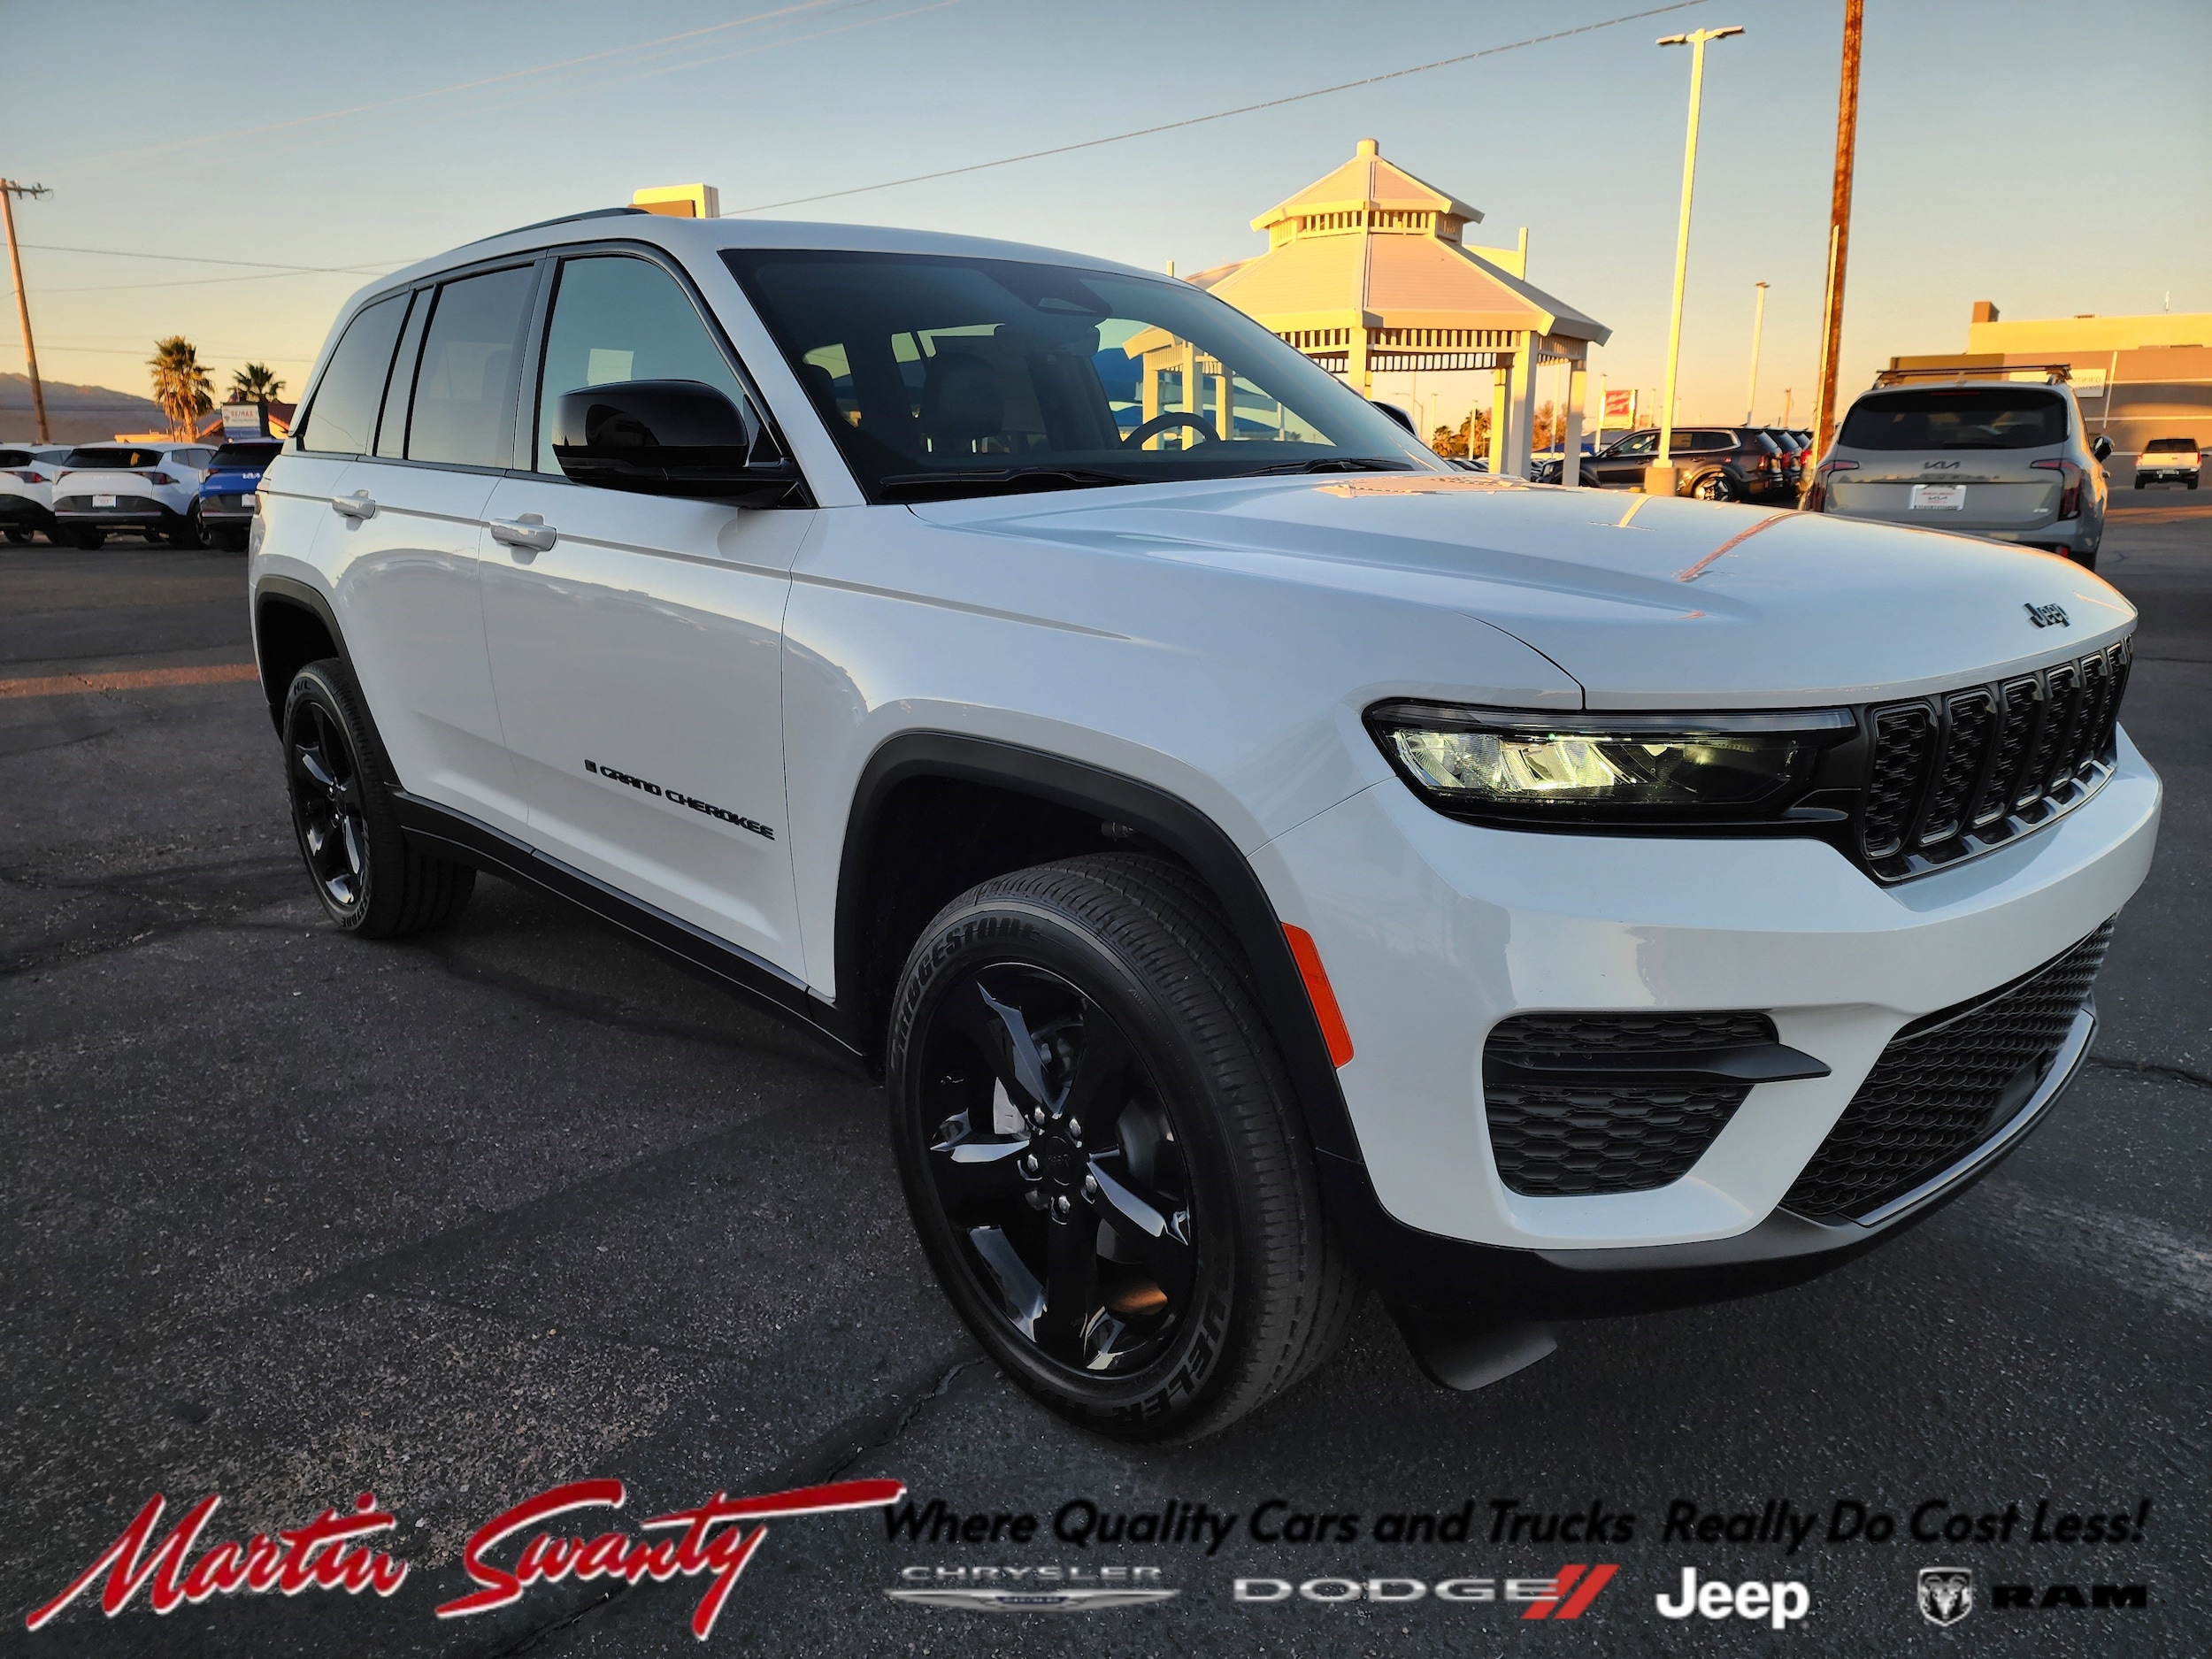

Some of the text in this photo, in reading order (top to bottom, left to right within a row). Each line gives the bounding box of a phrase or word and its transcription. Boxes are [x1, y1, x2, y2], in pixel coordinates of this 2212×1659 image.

[1924, 461, 1961, 470] KIA
[2023, 603, 2070, 628] Jeep
[600, 765, 775, 841] GRAND CHEROKEE
